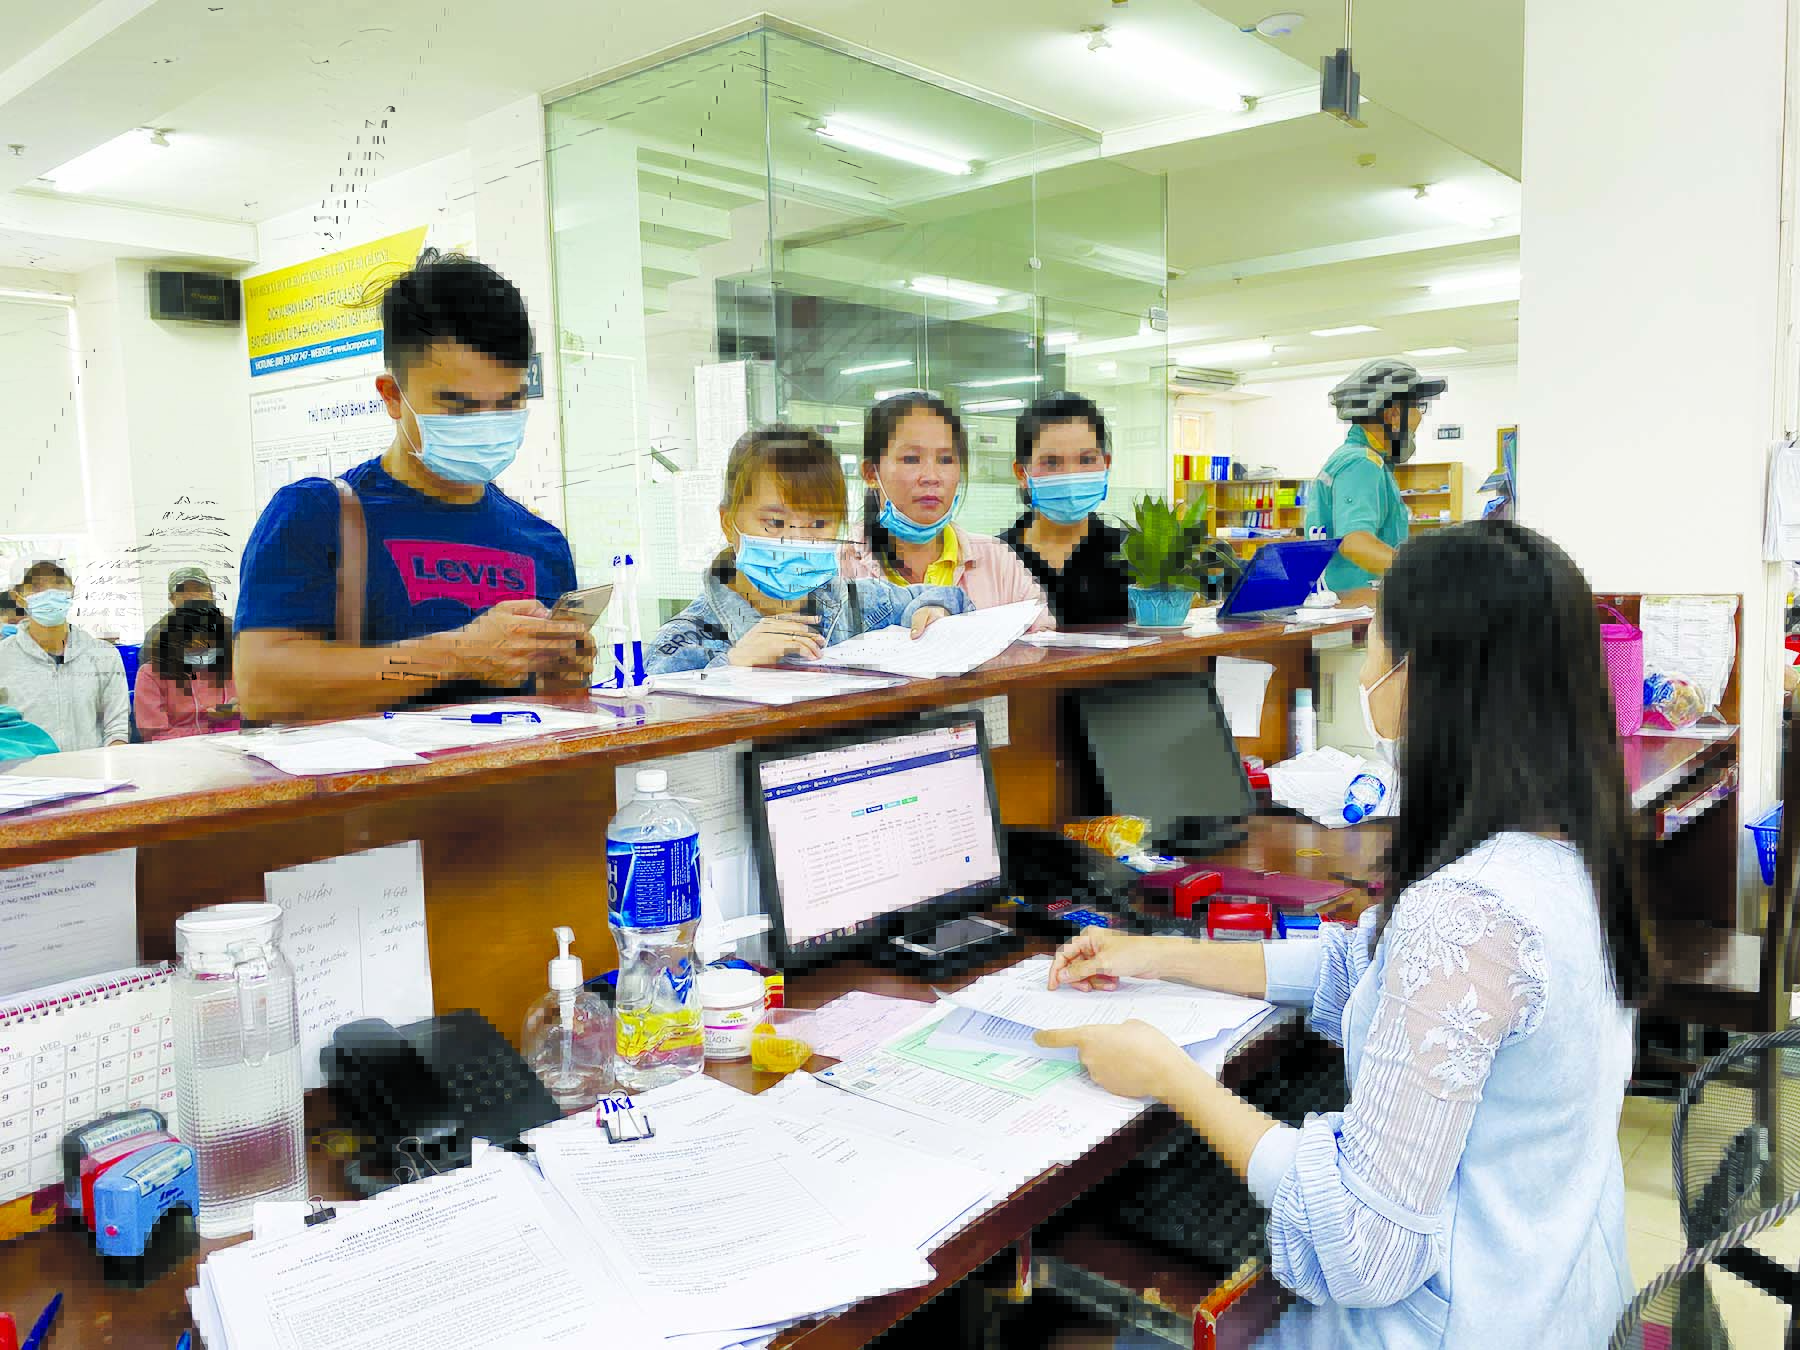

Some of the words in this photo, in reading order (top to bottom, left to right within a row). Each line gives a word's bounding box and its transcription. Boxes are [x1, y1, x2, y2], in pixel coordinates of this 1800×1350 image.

[2, 1066, 9, 1075] 2
[36, 1056, 43, 1064] 3
[102, 1036, 109, 1044] 5
[40, 1040, 61, 1051] WED
[75, 1032, 91, 1041] THU
[37, 1081, 48, 1090] 10
[101, 1060, 112, 1069] 12
[133, 1051, 143, 1059] 13
[2, 1119, 13, 1128] 16
[36, 1108, 45, 1117] 17
[100, 1086, 111, 1095] 19
[130, 1075, 144, 1085] 20
[161, 1066, 171, 1075] 21
[0, 1144, 15, 1154] 23
[34, 1132, 47, 1142] 24
[160, 1091, 173, 1100] 28
[0, 1169, 15, 1180] 30
